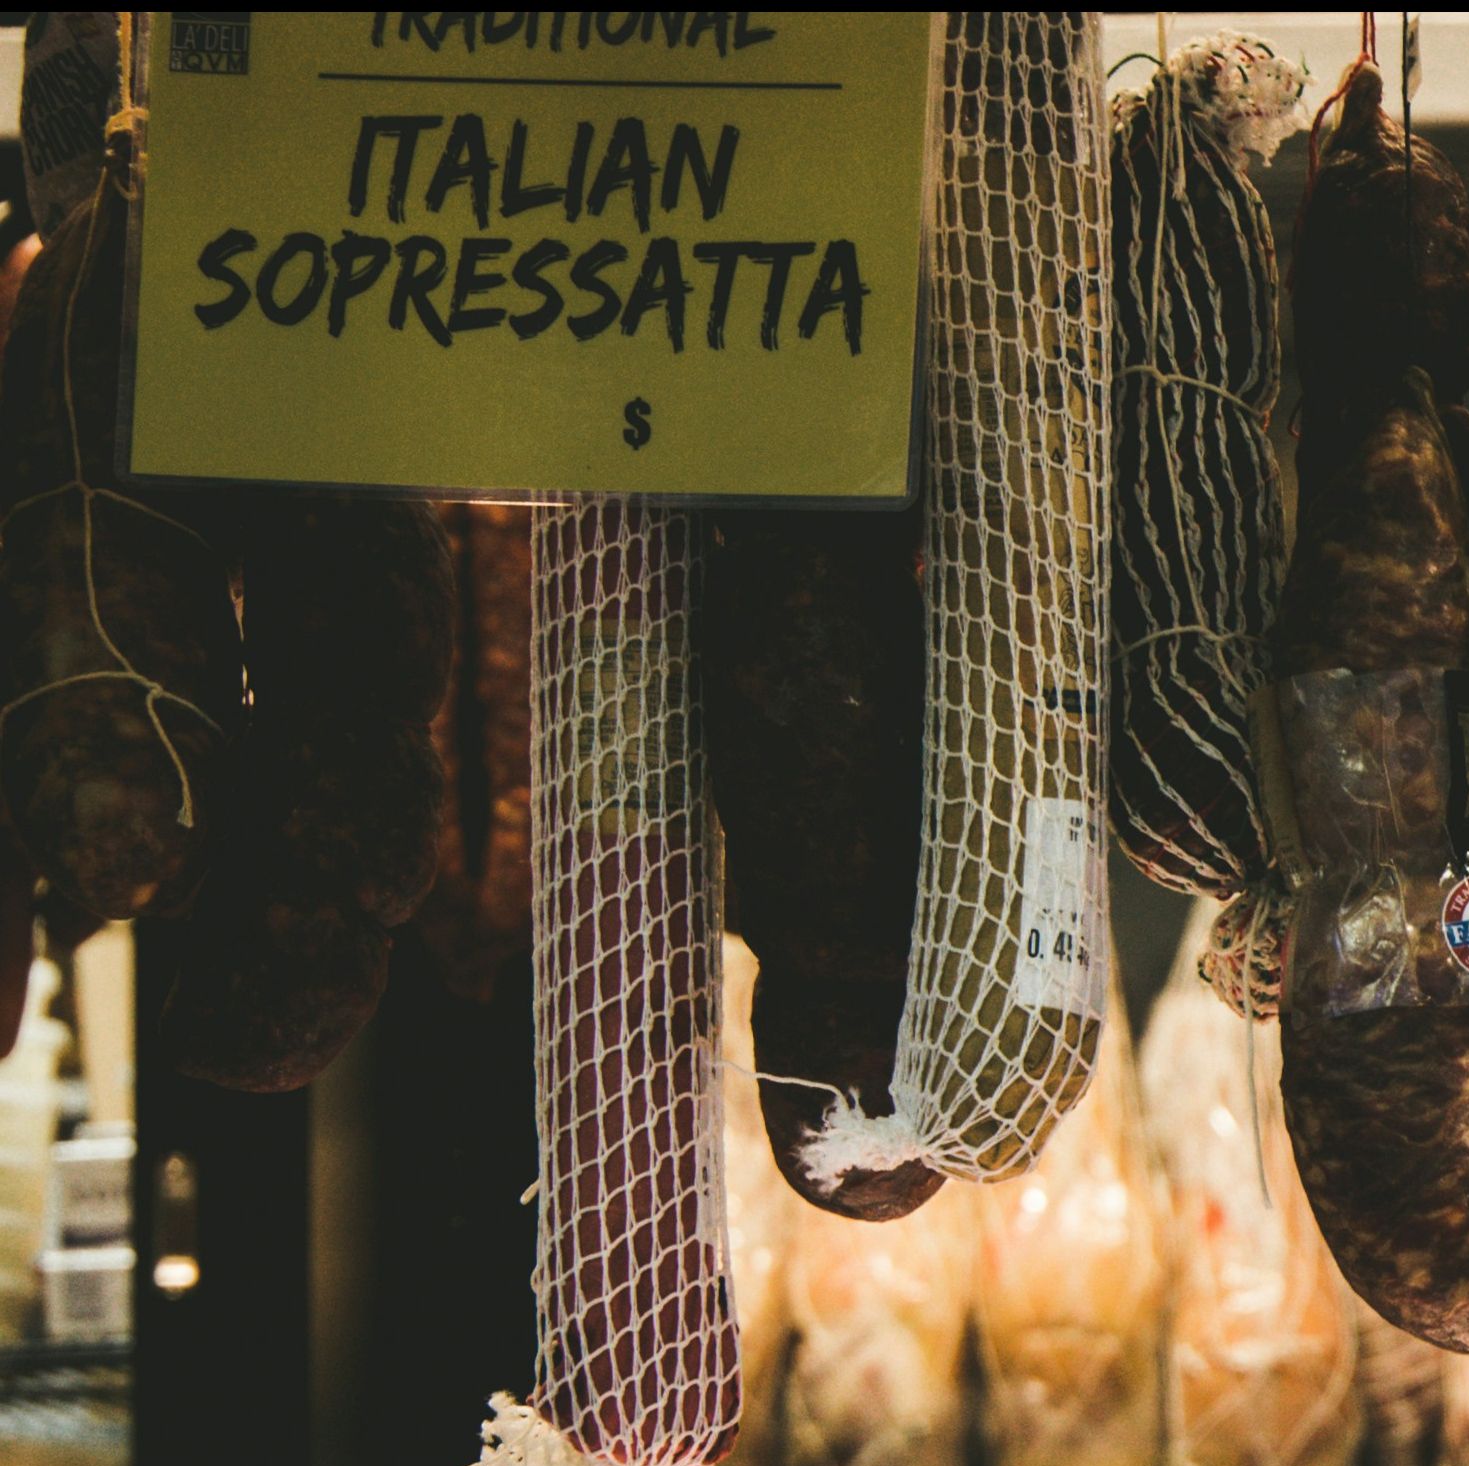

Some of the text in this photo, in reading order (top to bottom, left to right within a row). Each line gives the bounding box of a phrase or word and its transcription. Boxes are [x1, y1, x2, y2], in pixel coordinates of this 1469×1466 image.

[347, 113, 740, 231] ITALIAN
[194, 228, 871, 356] SOPRESSATTA
[622, 397, 651, 451] $
